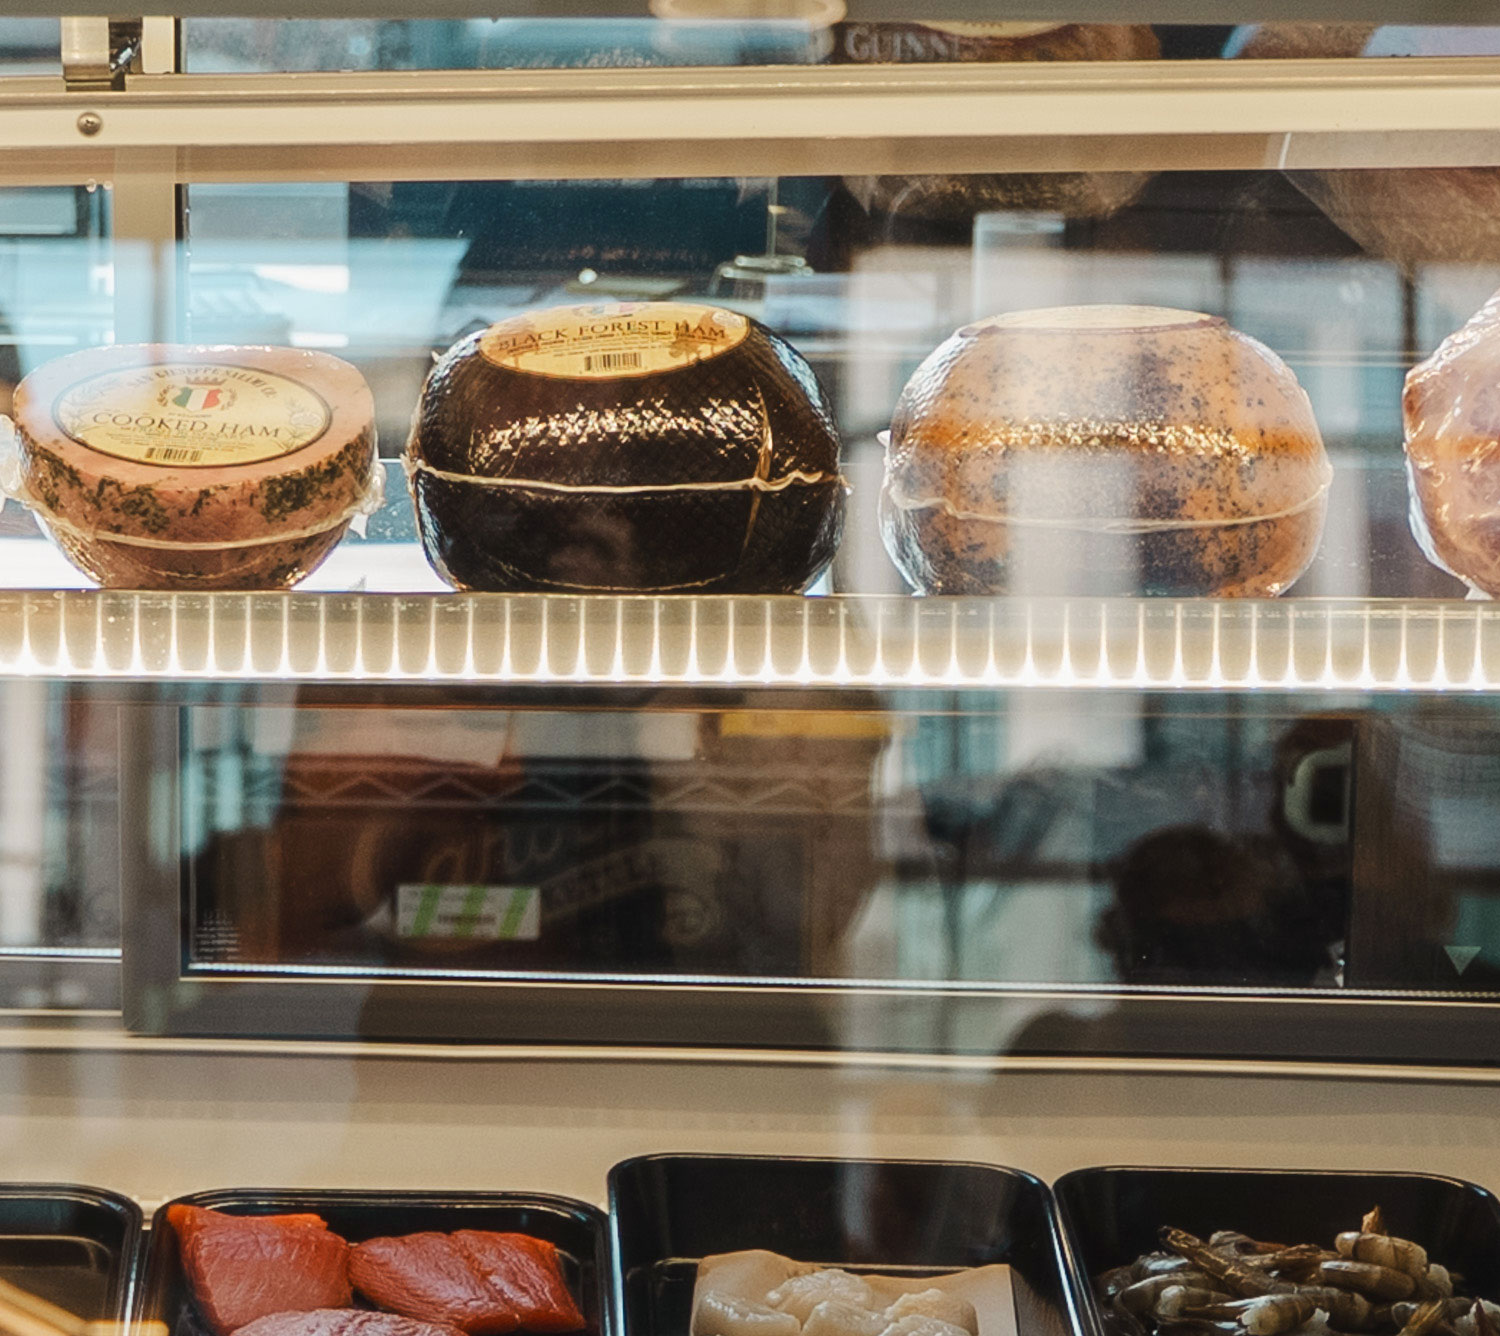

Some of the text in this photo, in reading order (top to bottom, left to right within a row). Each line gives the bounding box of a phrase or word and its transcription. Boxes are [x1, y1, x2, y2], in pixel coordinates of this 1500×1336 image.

[497, 327, 569, 352] BLACK
[578, 319, 666, 338] FOREST
[675, 320, 727, 339] HAM
[92, 411, 280, 439] COOKED HAM
